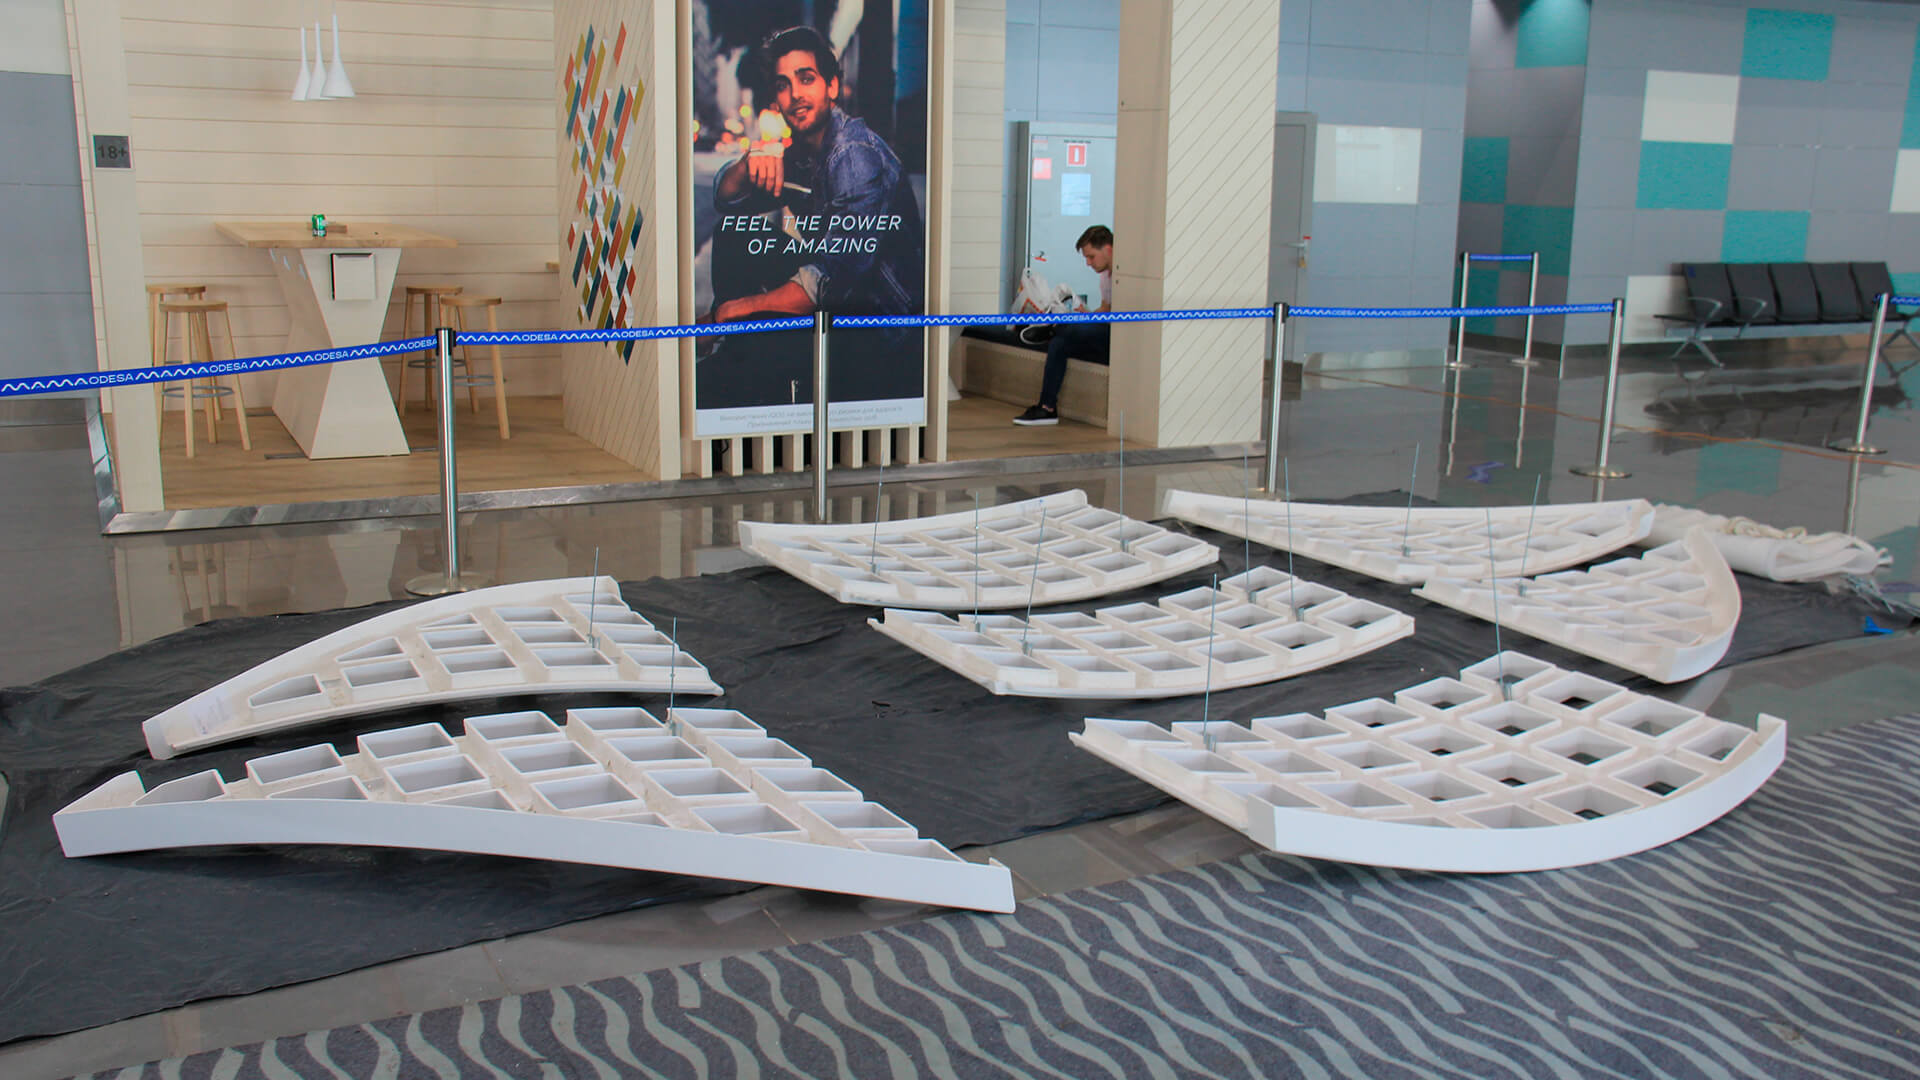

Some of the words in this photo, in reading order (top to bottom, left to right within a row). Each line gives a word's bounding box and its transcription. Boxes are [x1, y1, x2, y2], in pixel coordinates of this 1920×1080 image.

[97, 144, 128, 160] 18+
[721, 215, 773, 231] FEEL
[783, 215, 822, 231] THE
[828, 215, 902, 231] POWER
[748, 238, 777, 255] OF
[783, 237, 878, 254] AMAZING
[889, 316, 922, 325] ODESA
[977, 315, 1008, 324] ODESA
[1061, 314, 1090, 322] ODESA
[1140, 312, 1169, 320] ODESA
[521, 332, 558, 342] ODESA
[621, 329, 654, 339] ODESA
[713, 323, 745, 333] ODESA
[88, 373, 134, 385] ODESA
[209, 361, 249, 373] ODESA
[314, 350, 350, 361] ODESA
[407, 338, 438, 349] ODESA
